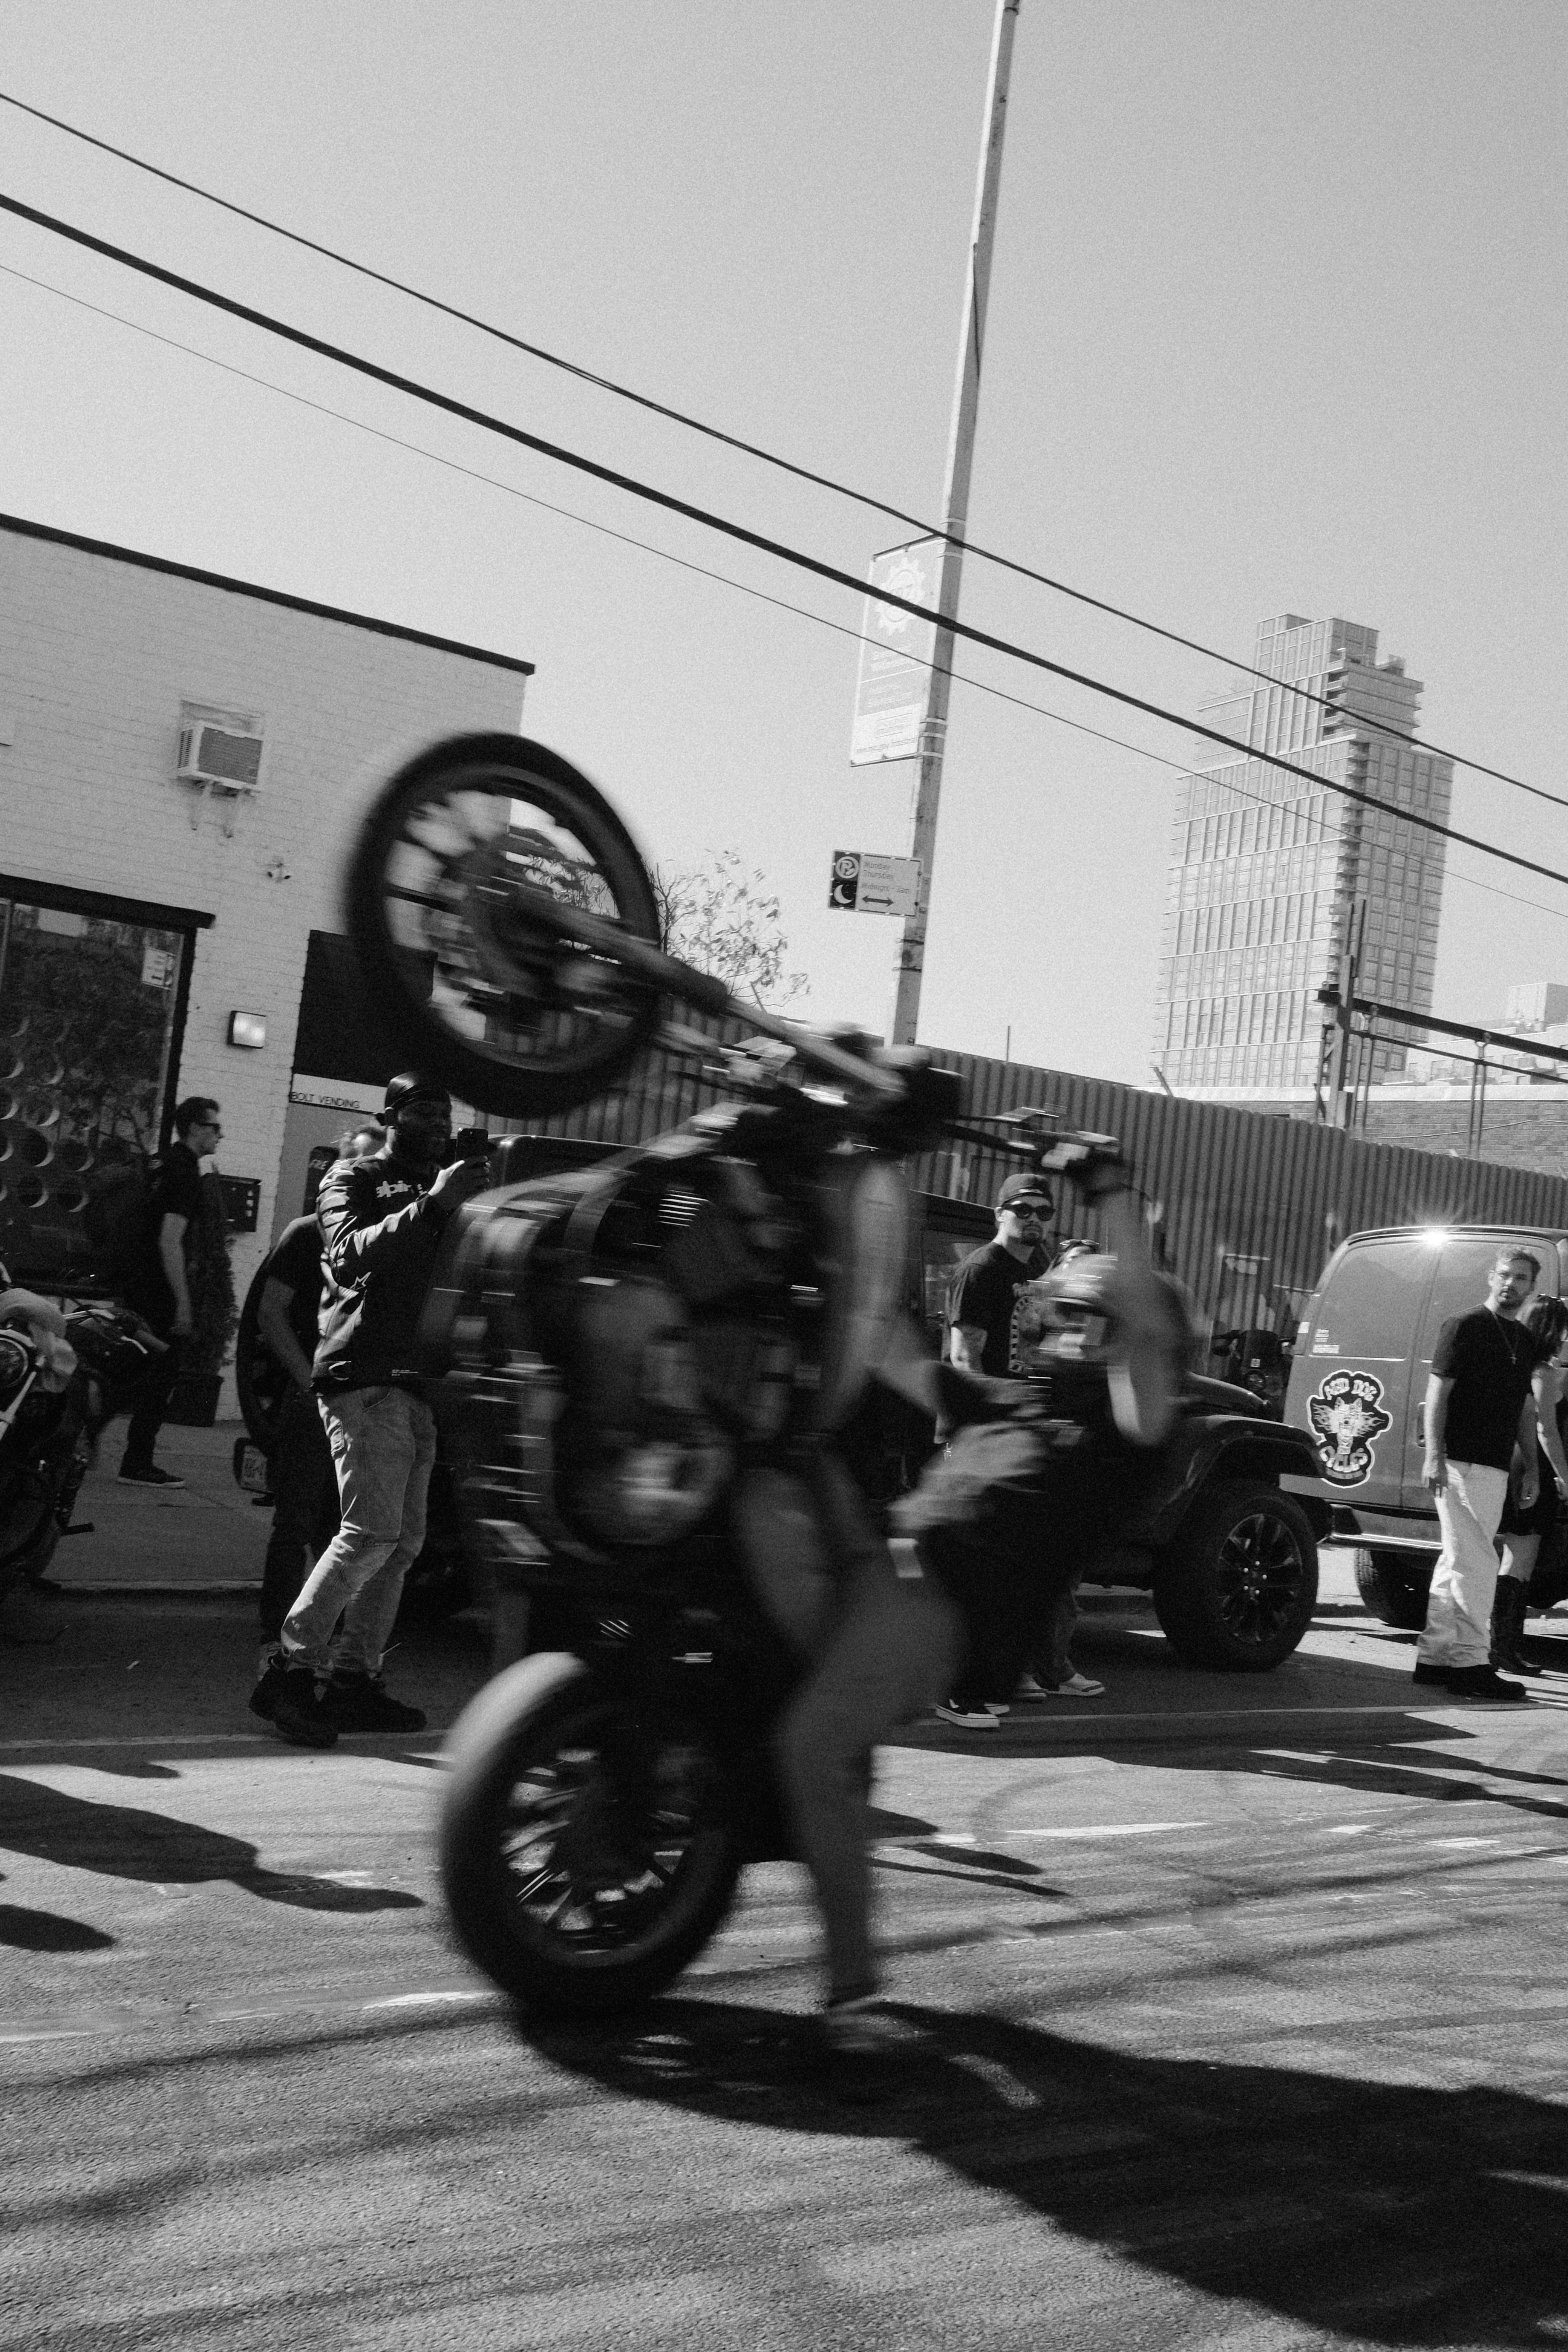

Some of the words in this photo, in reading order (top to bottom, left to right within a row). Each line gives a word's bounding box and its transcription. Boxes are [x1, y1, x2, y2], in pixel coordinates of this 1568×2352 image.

[291, 1092, 315, 1102] BOLT
[319, 1096, 360, 1109] VENDING
[1351, 1380, 1377, 1401] DOG
